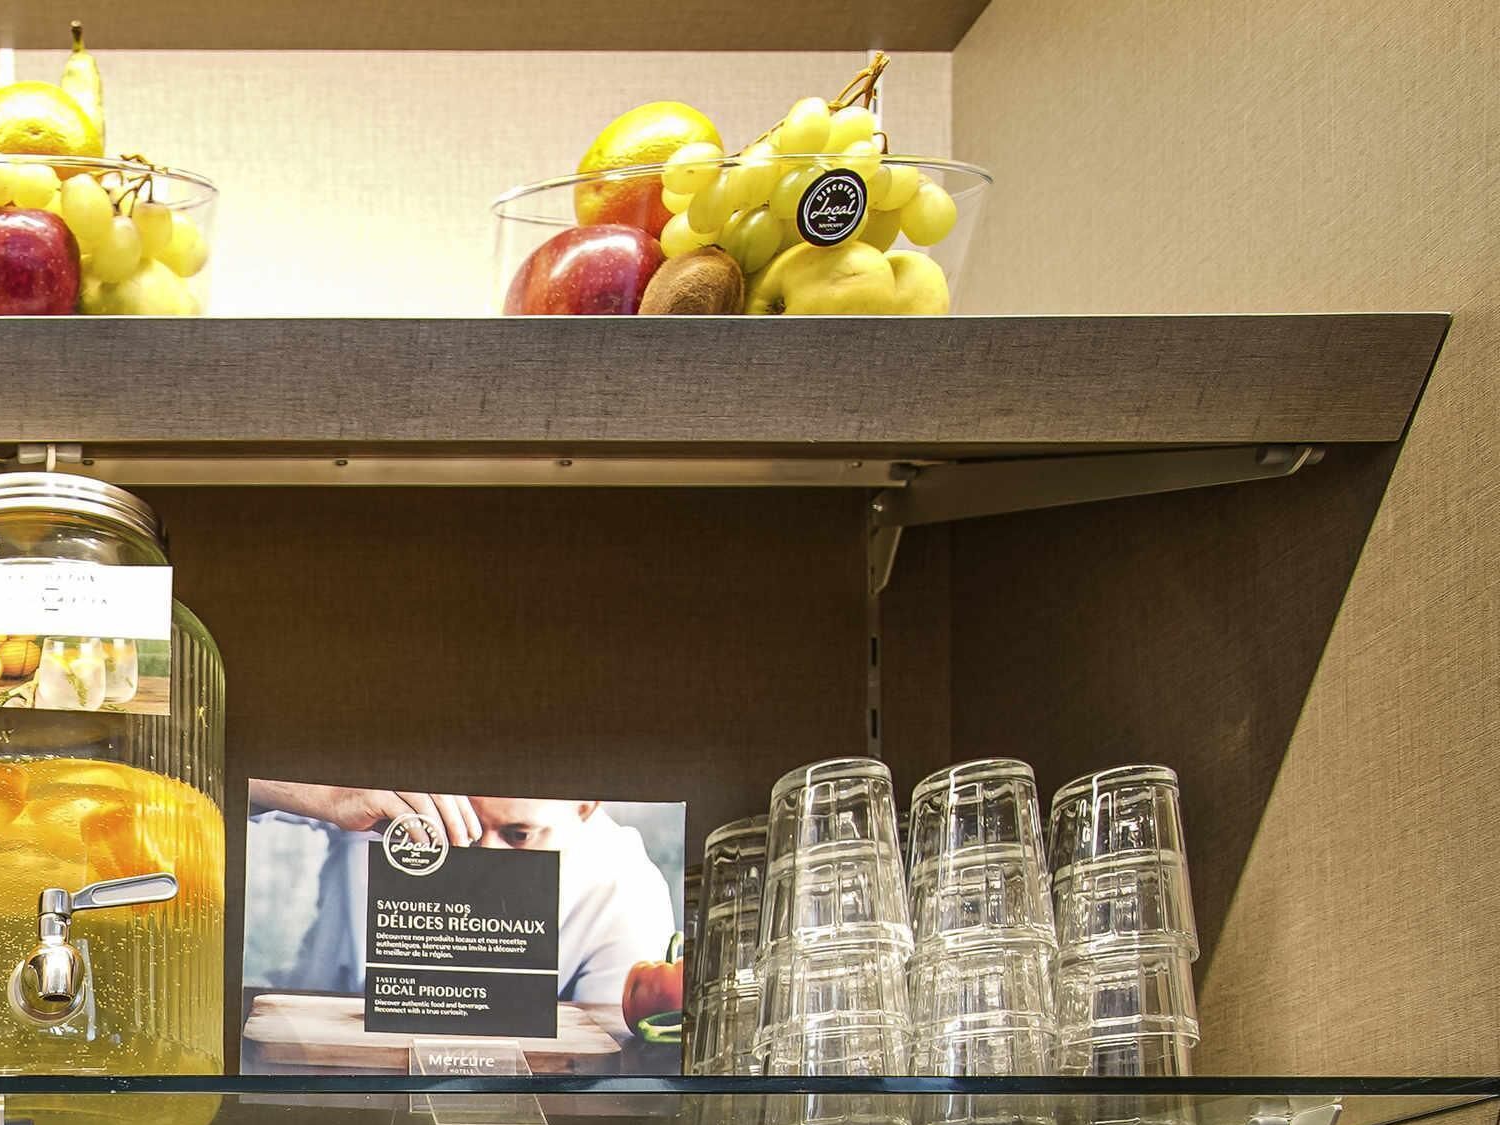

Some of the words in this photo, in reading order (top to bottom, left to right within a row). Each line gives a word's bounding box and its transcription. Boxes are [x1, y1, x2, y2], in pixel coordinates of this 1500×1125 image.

[816, 183, 856, 201] DISCOVER
[810, 197, 856, 219] Local
[391, 832, 441, 853] Local
[377, 900, 441, 914] SAVOUREZ
[445, 903, 471, 915] NOS
[377, 911, 443, 930] DÉLICES
[449, 914, 546, 935] RÉGIONAUX
[376, 932, 411, 940] Découvrez
[426, 934, 454, 943] produits
[456, 935, 477, 943] locaux
[500, 937, 527, 945] recettes
[376, 941, 421, 950] authentiques.
[468, 944, 487, 952] invite
[493, 945, 527, 953] découvrir
[383, 949, 411, 957] meilleur
[429, 951, 453, 959] région.
[376, 976, 397, 984] TASTE
[375, 984, 416, 996] LOCAL
[419, 986, 487, 998] PRODUCTS
[374, 999, 400, 1007] Discover
[458, 1002, 490, 1010] beverages.
[429, 1055, 495, 1067] Mercure
